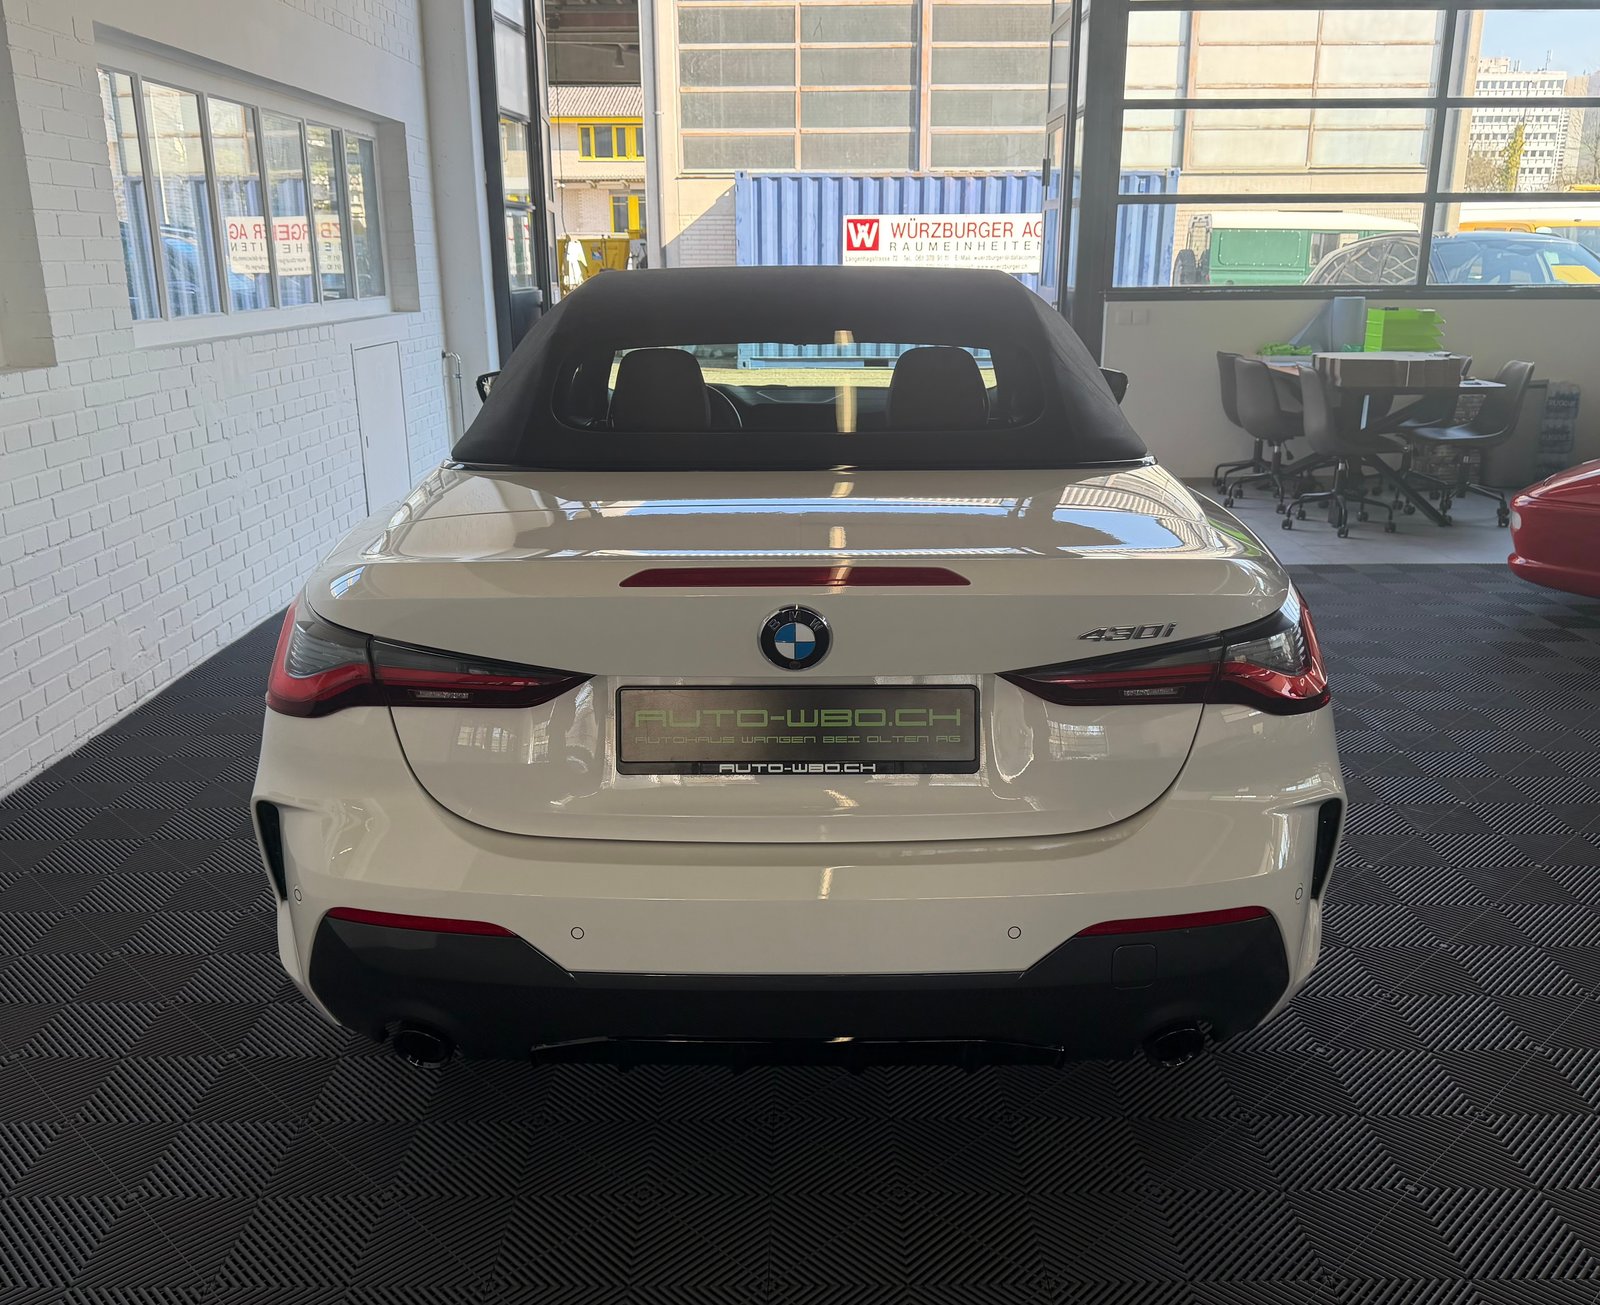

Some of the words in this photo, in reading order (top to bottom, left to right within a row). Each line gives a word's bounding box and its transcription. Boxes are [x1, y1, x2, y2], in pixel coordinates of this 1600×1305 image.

[890, 217, 1014, 239] WÜRZBURGER
[767, 611, 824, 632] BMW
[1078, 621, 1177, 641] 430i
[635, 708, 961, 728] AUTO-WBO.CH
[635, 736, 735, 744] AUTOHAUS
[741, 736, 817, 744] WANGEN
[822, 735, 860, 744] BEI
[866, 735, 929, 743] OLTEN
[935, 735, 961, 743] AG
[719, 763, 876, 773] AUTO-WBO.CH
